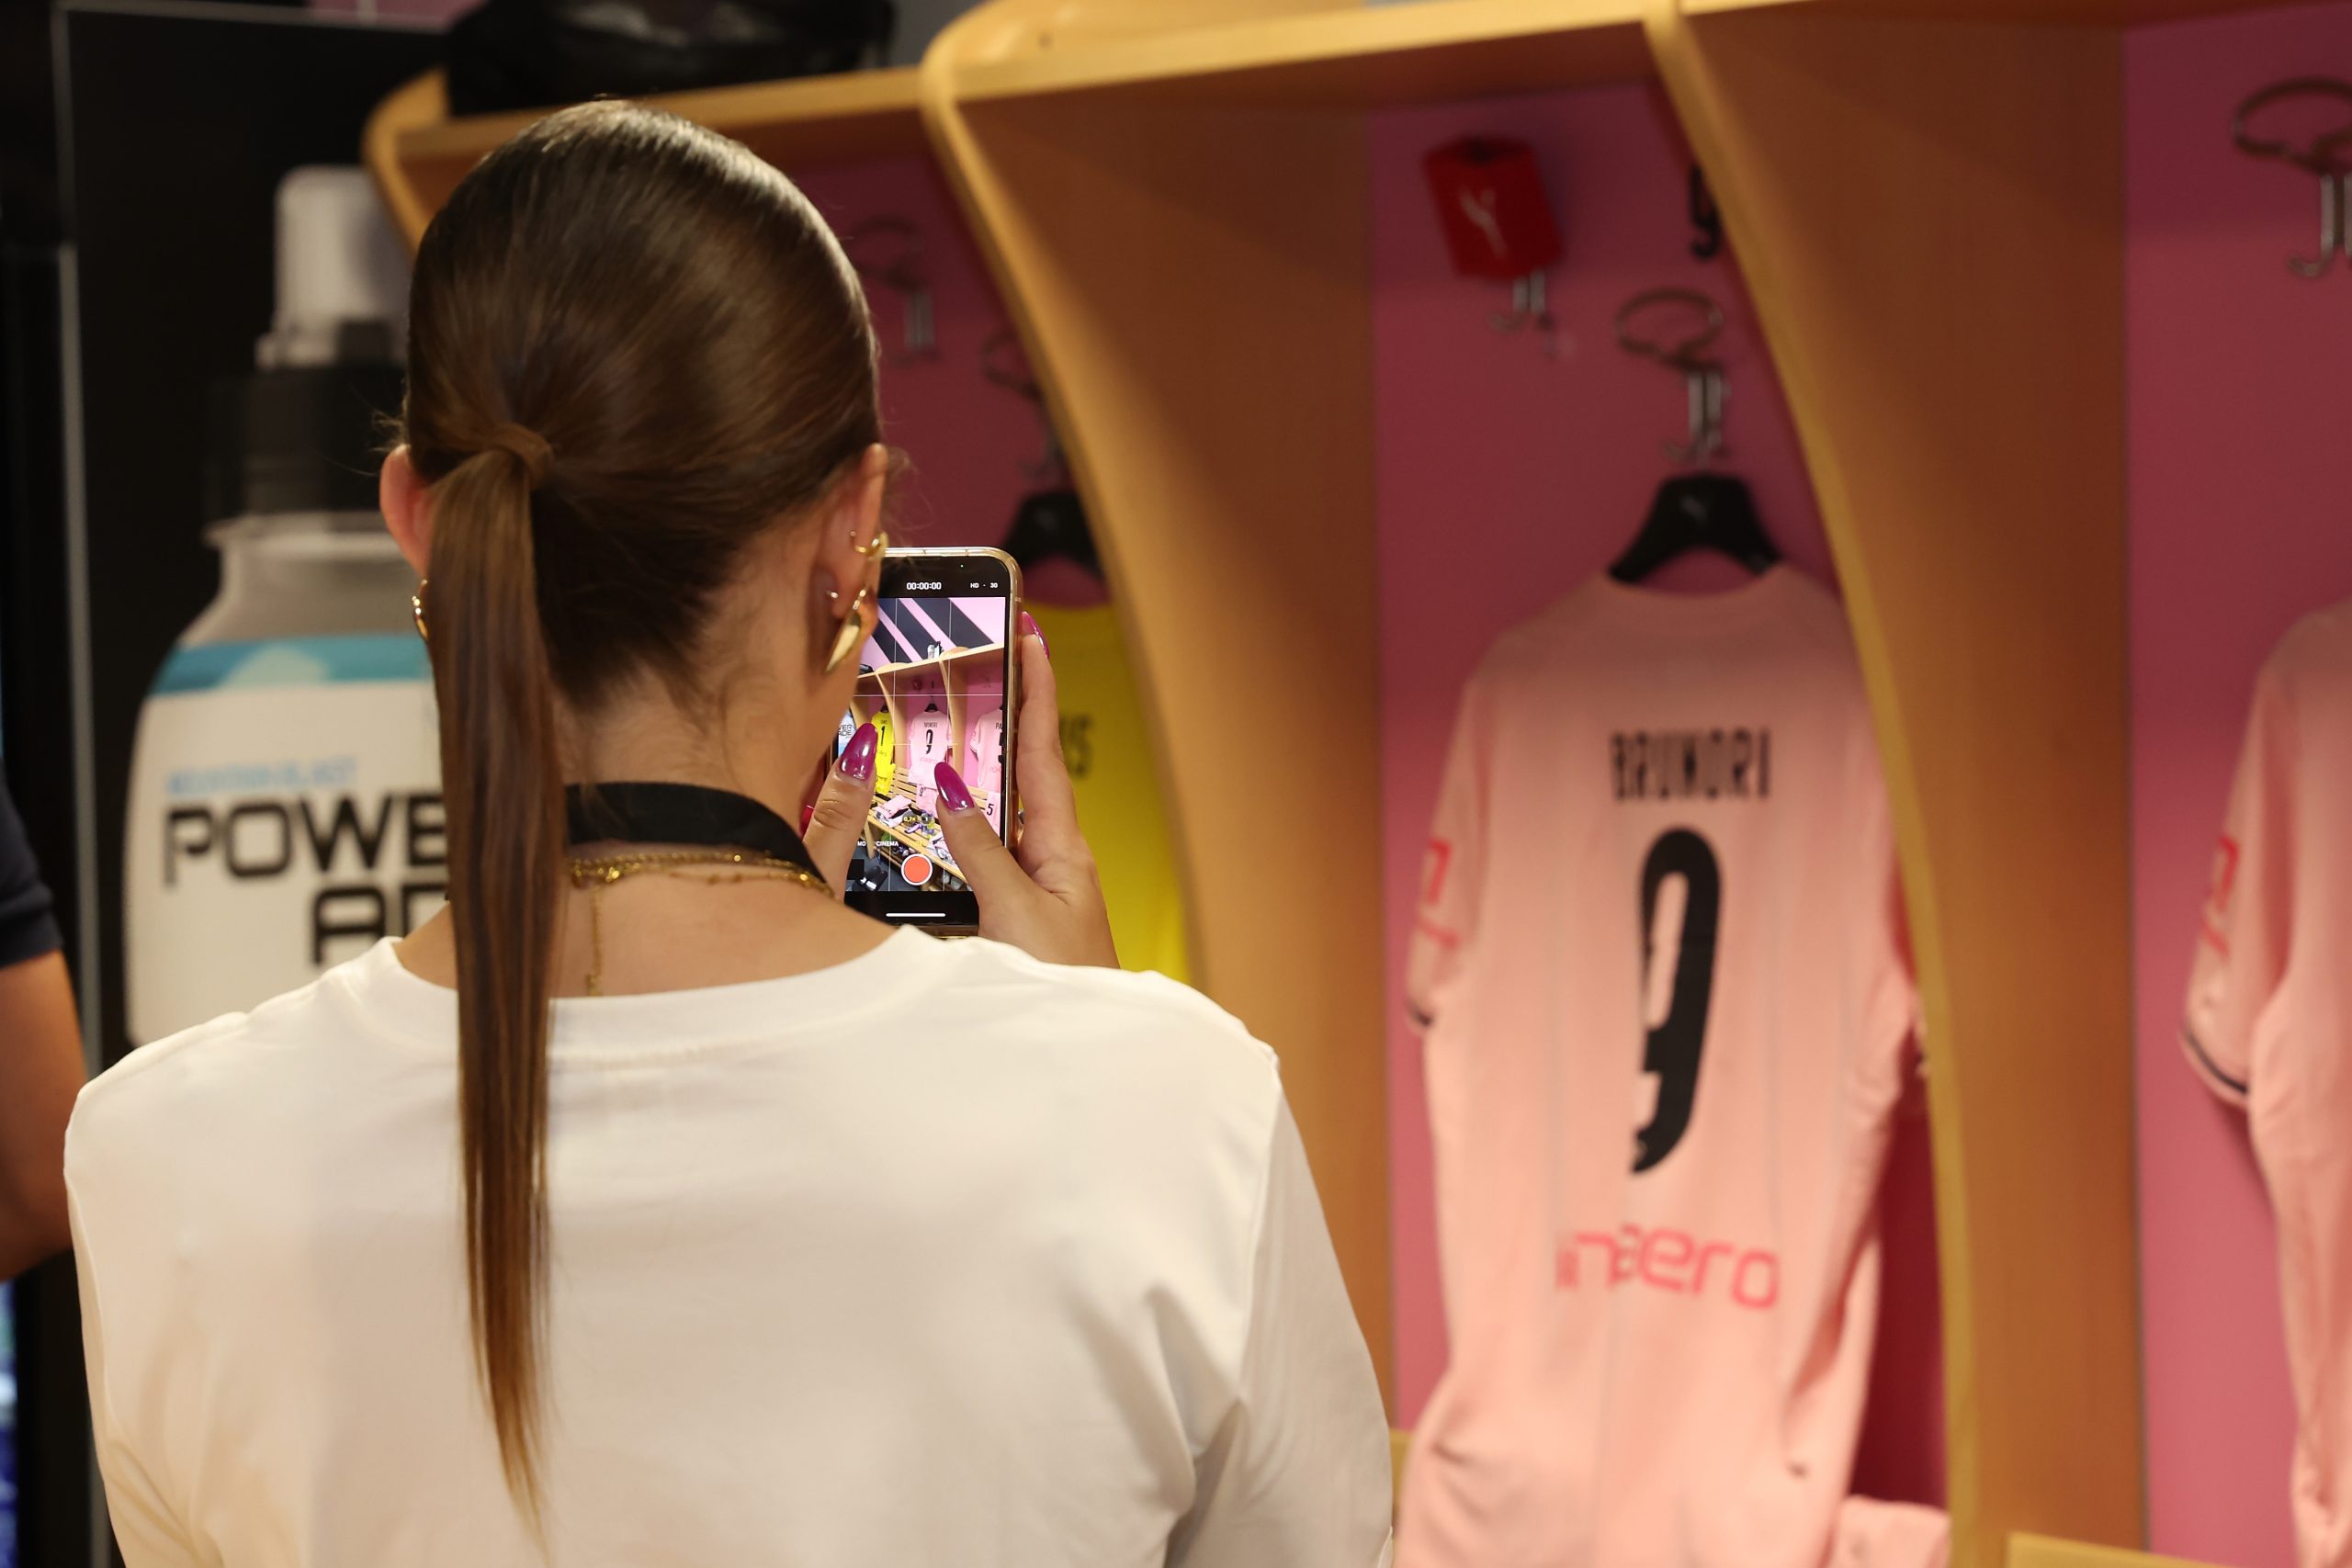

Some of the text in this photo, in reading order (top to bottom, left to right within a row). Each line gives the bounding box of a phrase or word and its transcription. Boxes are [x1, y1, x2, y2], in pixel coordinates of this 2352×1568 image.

[906, 581, 943, 591] 00:00:00
[925, 728, 933, 754] 9
[987, 803, 994, 816] 5
[1632, 826, 1723, 1175] 9
